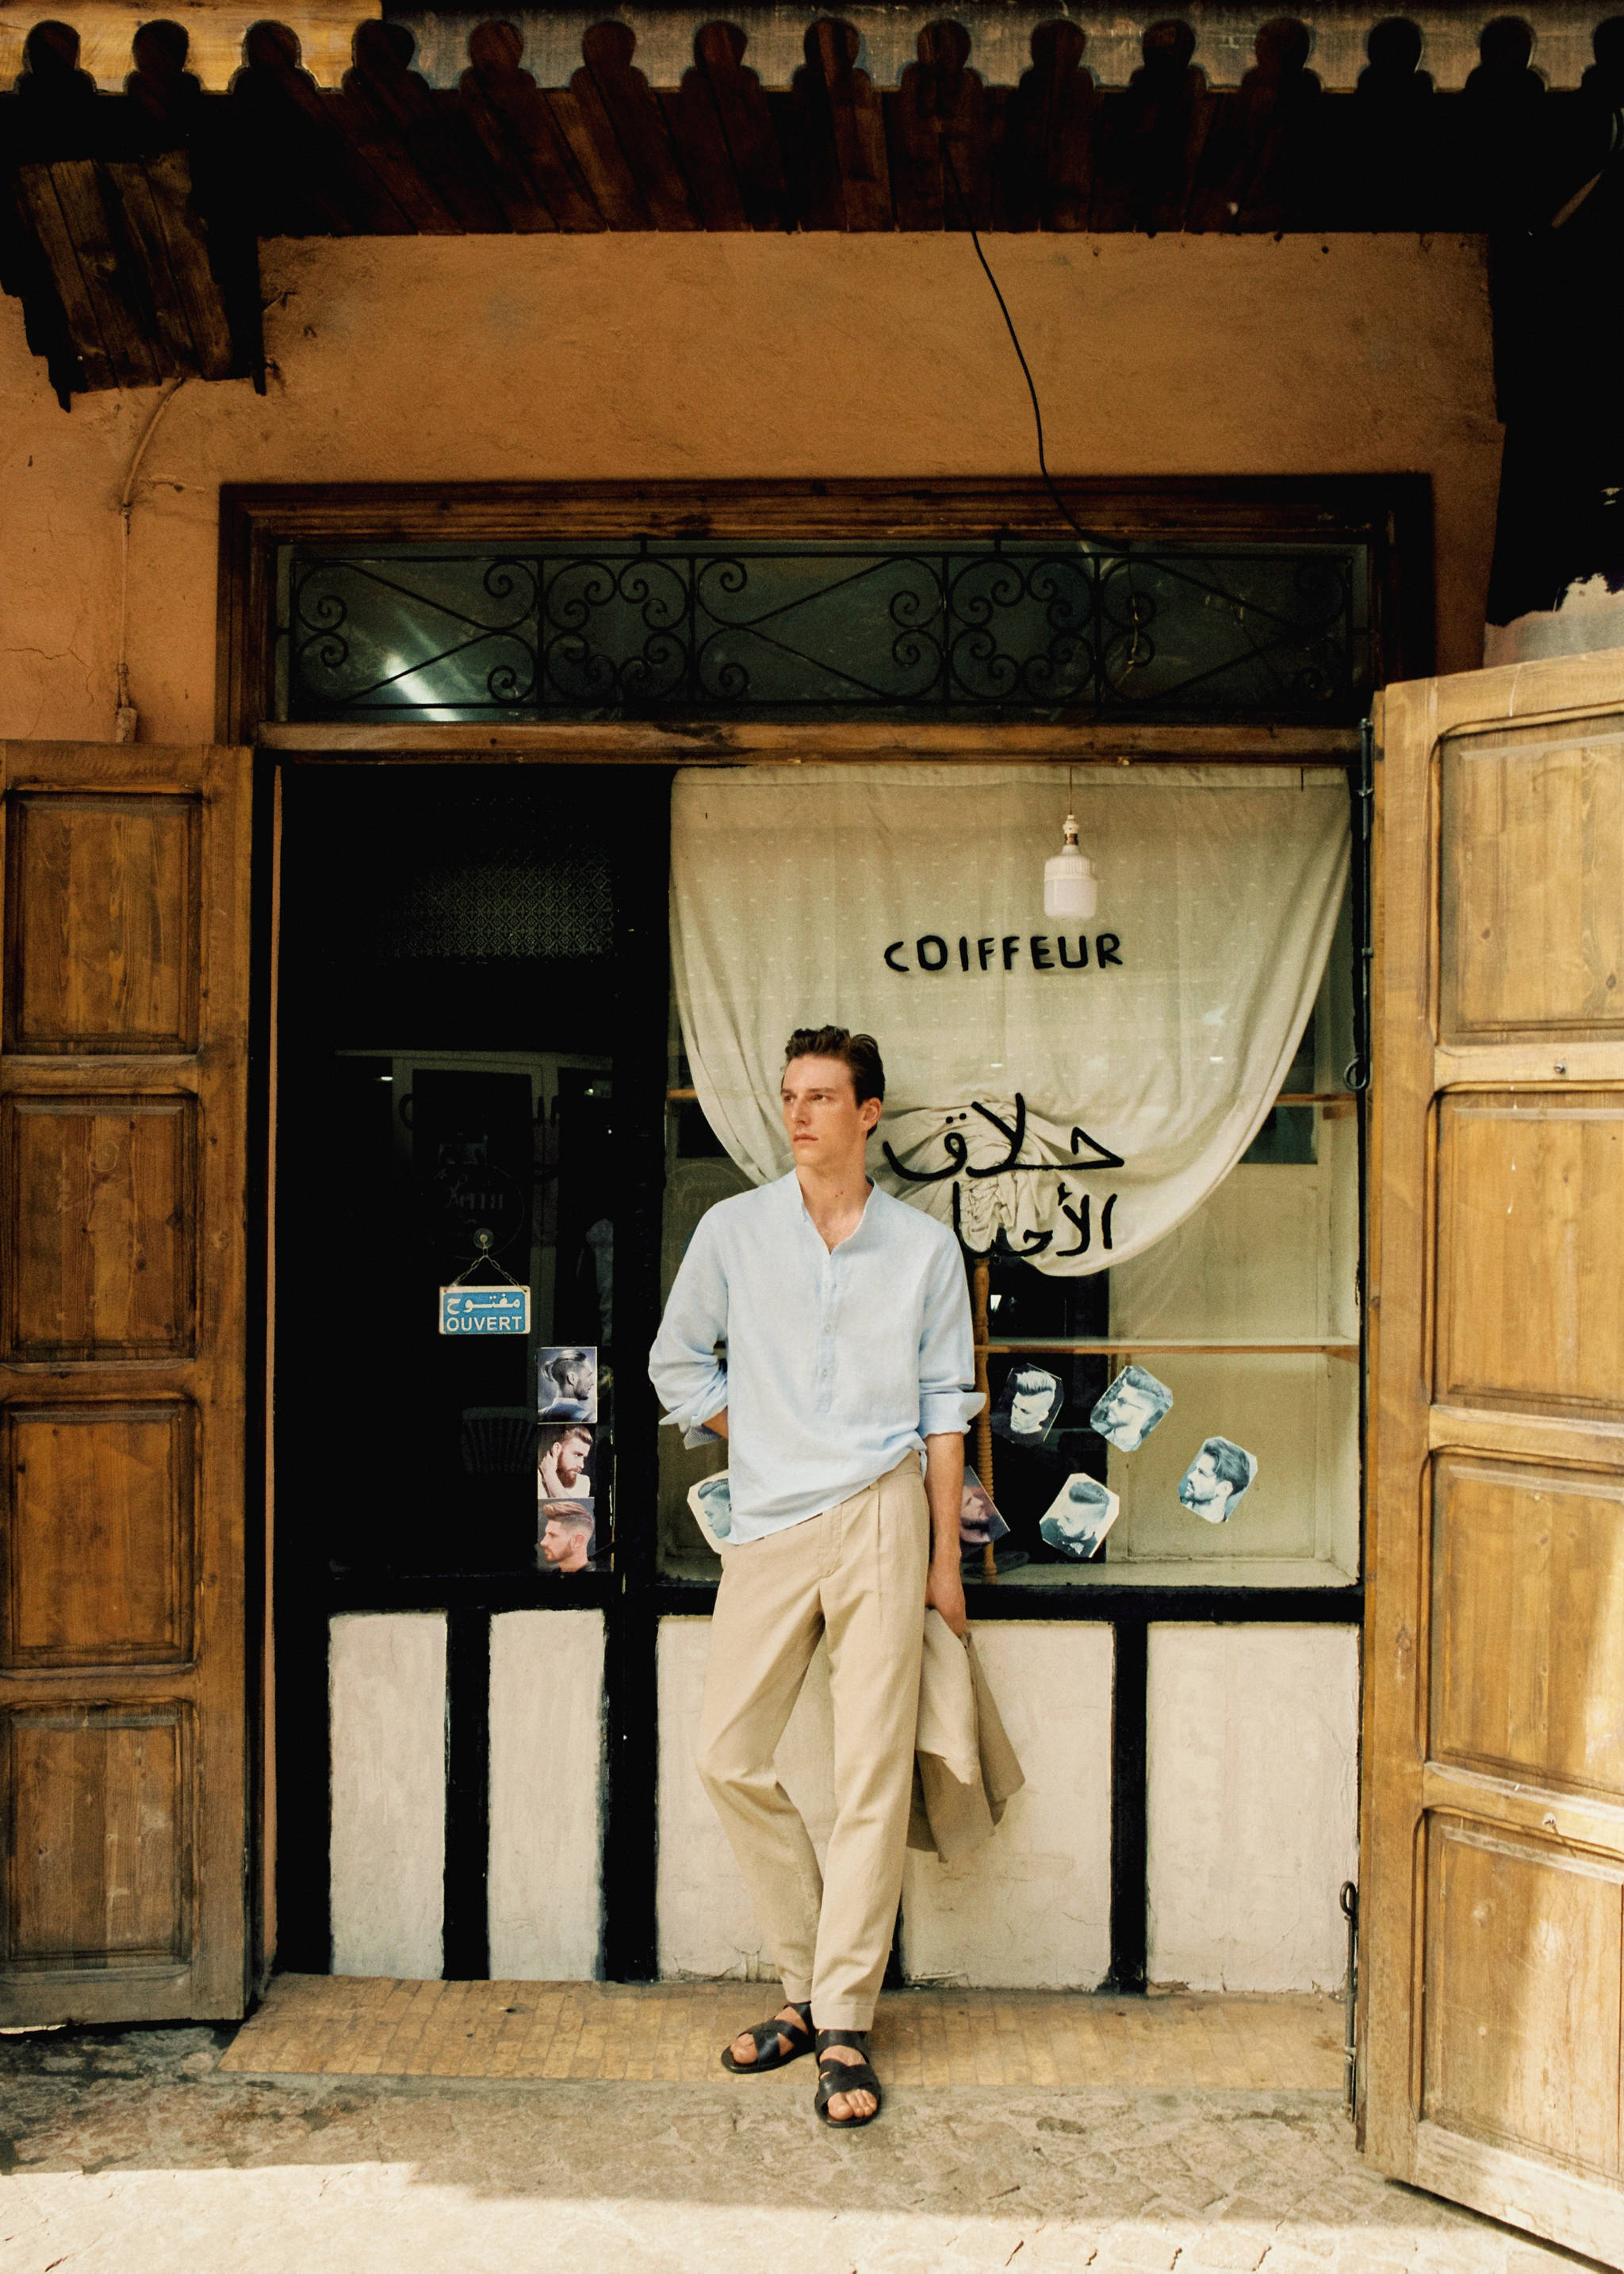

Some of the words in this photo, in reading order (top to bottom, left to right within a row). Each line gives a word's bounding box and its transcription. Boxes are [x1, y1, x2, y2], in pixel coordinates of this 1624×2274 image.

[883, 933, 1123, 971] COIFFEUR
[883, 1093, 1124, 1181] حلاق
[446, 1293, 521, 1315] مفتوح
[446, 1316, 523, 1332] OUVERT
